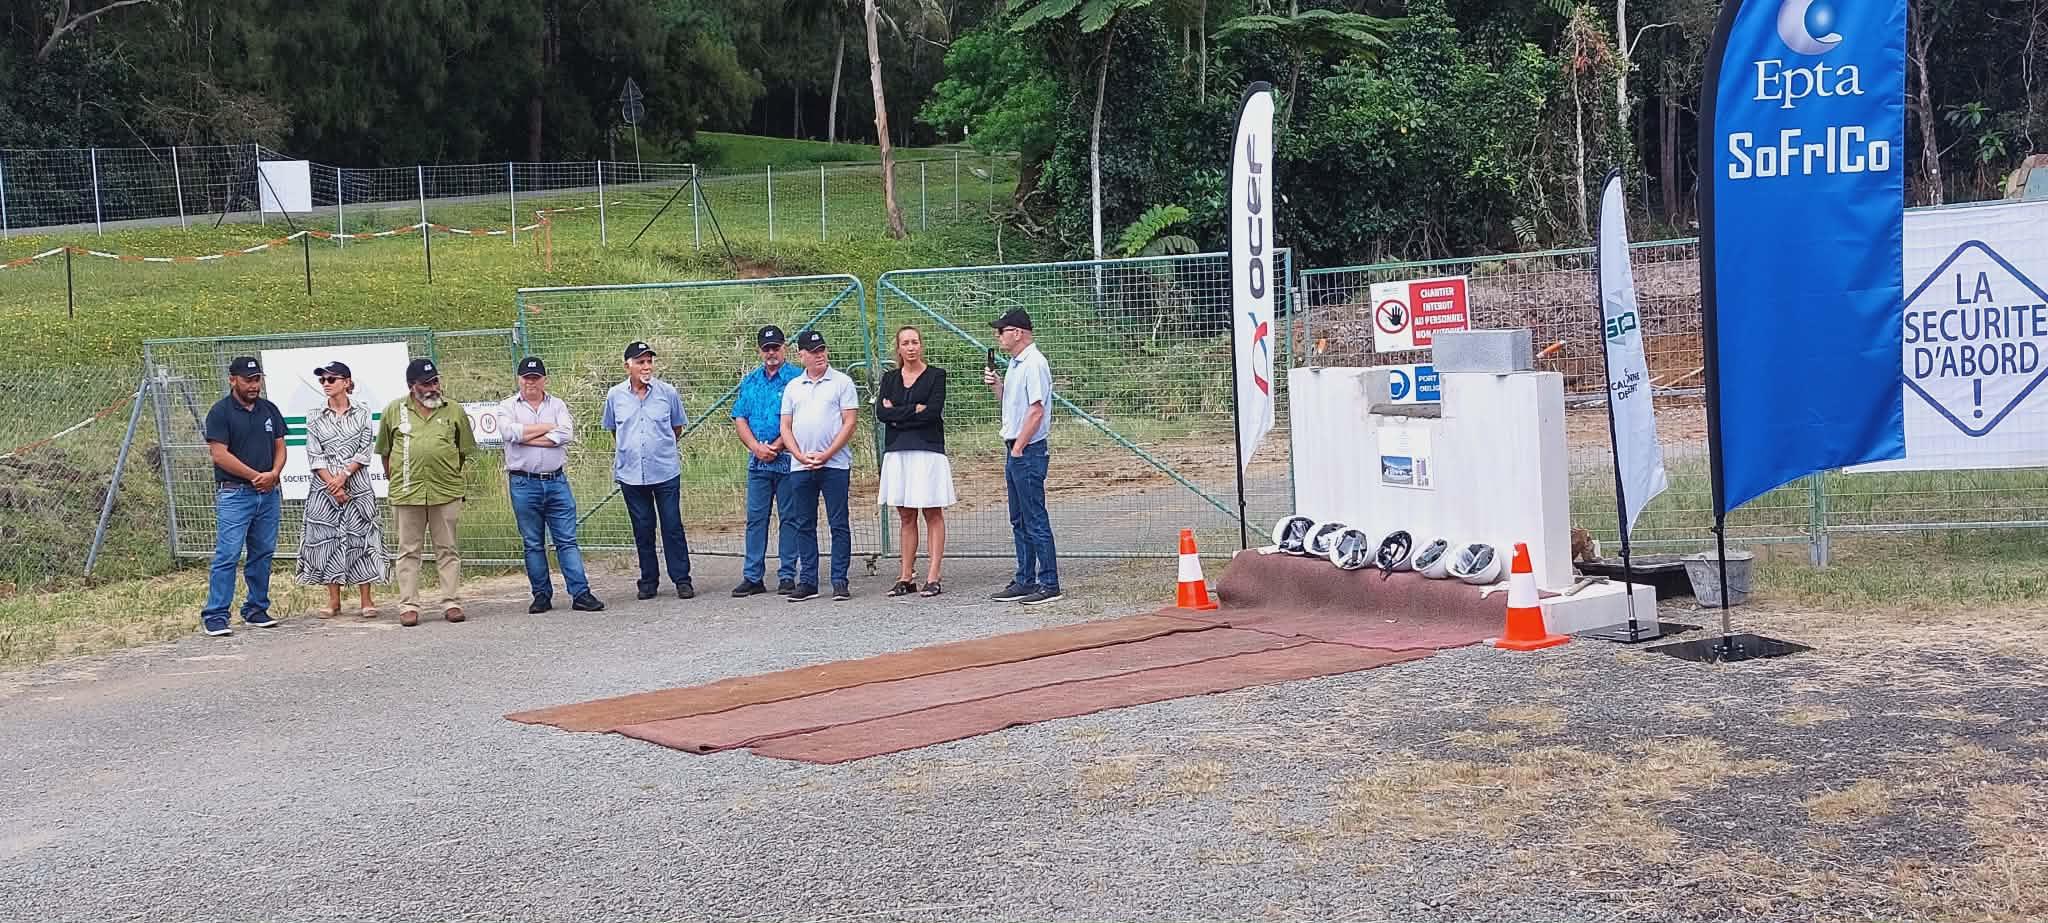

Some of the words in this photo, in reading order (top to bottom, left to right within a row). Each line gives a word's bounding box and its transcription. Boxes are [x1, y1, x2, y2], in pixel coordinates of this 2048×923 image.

[1753, 59, 1864, 109] Epta
[1420, 287, 1454, 298] CHANTIER
[1956, 272, 1993, 305] LA
[1904, 304, 2047, 344] SECURITE
[1914, 342, 2039, 379] D'ABORD
[1973, 378, 1984, 419] !
